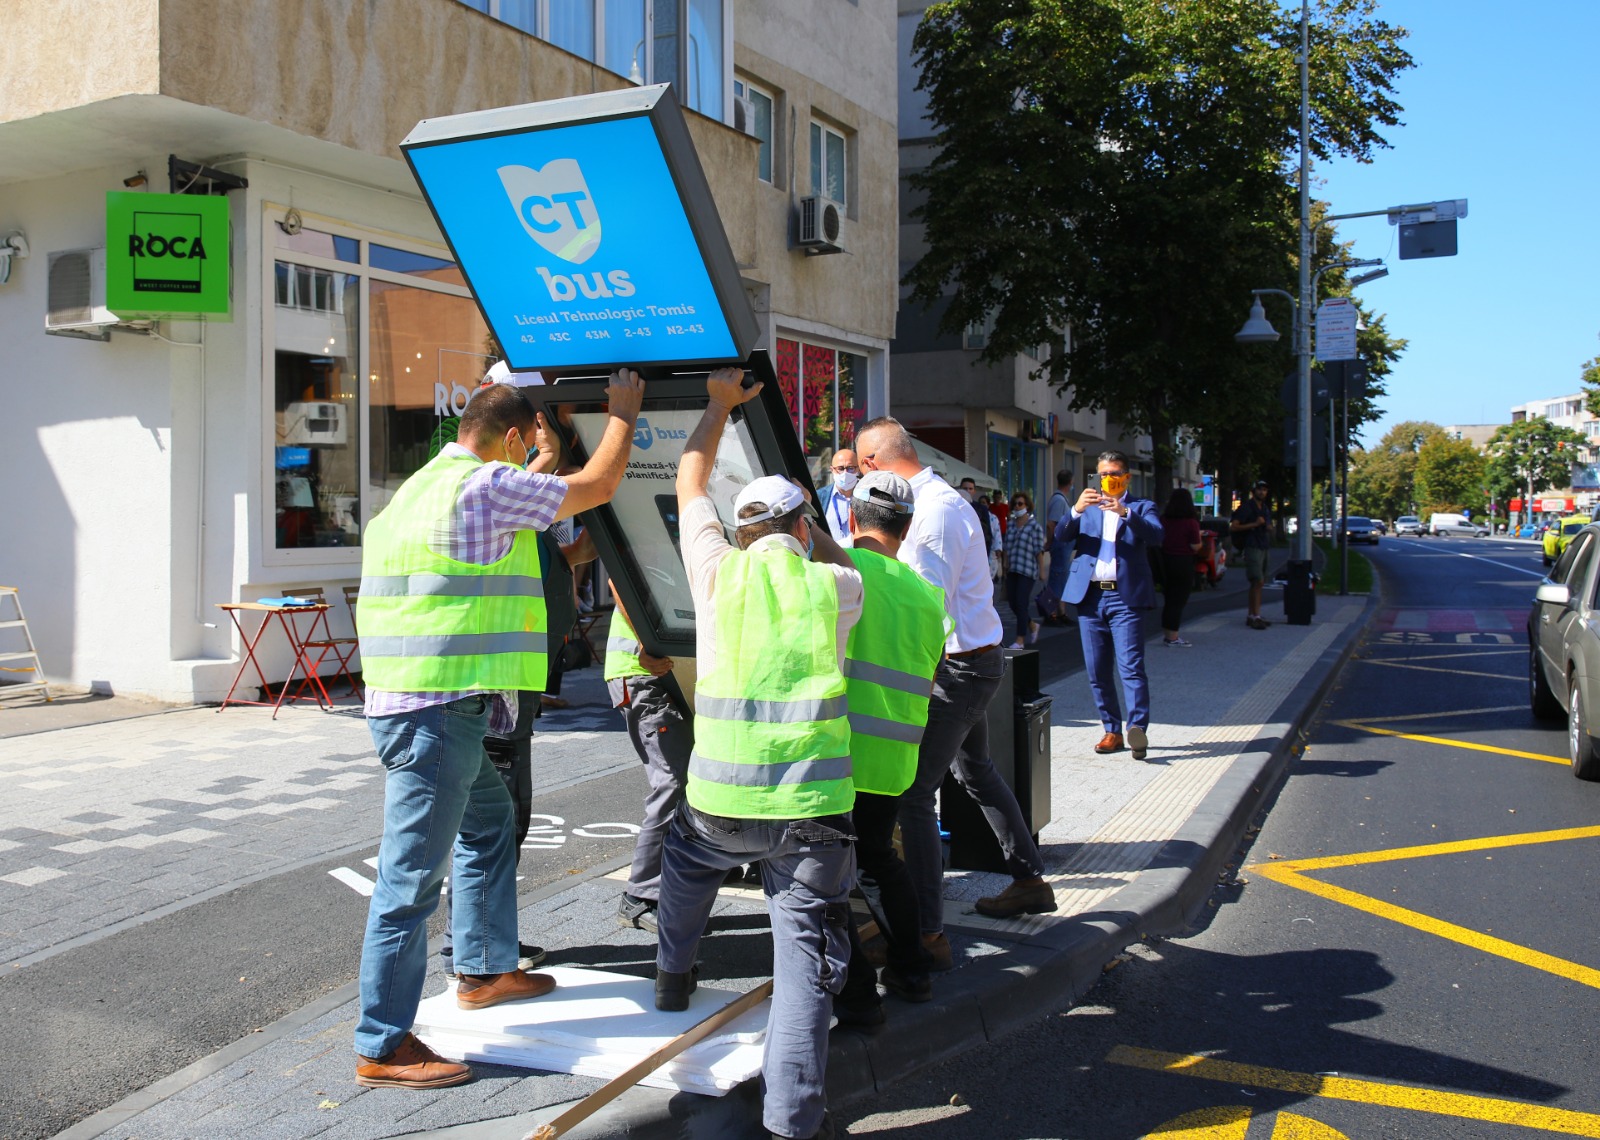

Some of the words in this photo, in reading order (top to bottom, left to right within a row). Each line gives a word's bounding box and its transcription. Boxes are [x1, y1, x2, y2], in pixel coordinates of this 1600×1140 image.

[520, 190, 587, 234] CT
[535, 266, 636, 303] bus
[513, 313, 560, 326] Liceul
[560, 307, 646, 322] Tehnologic
[646, 303, 696, 317] Tomis
[520, 334, 536, 344] 42
[549, 332, 572, 342] 43C
[585, 329, 611, 340] 43M
[623, 327, 652, 338] 2-43
[666, 324, 705, 335] N2-43
[434, 380, 481, 416] RO
[654, 426, 688, 440] bus
[625, 461, 678, 471] talează-ți
